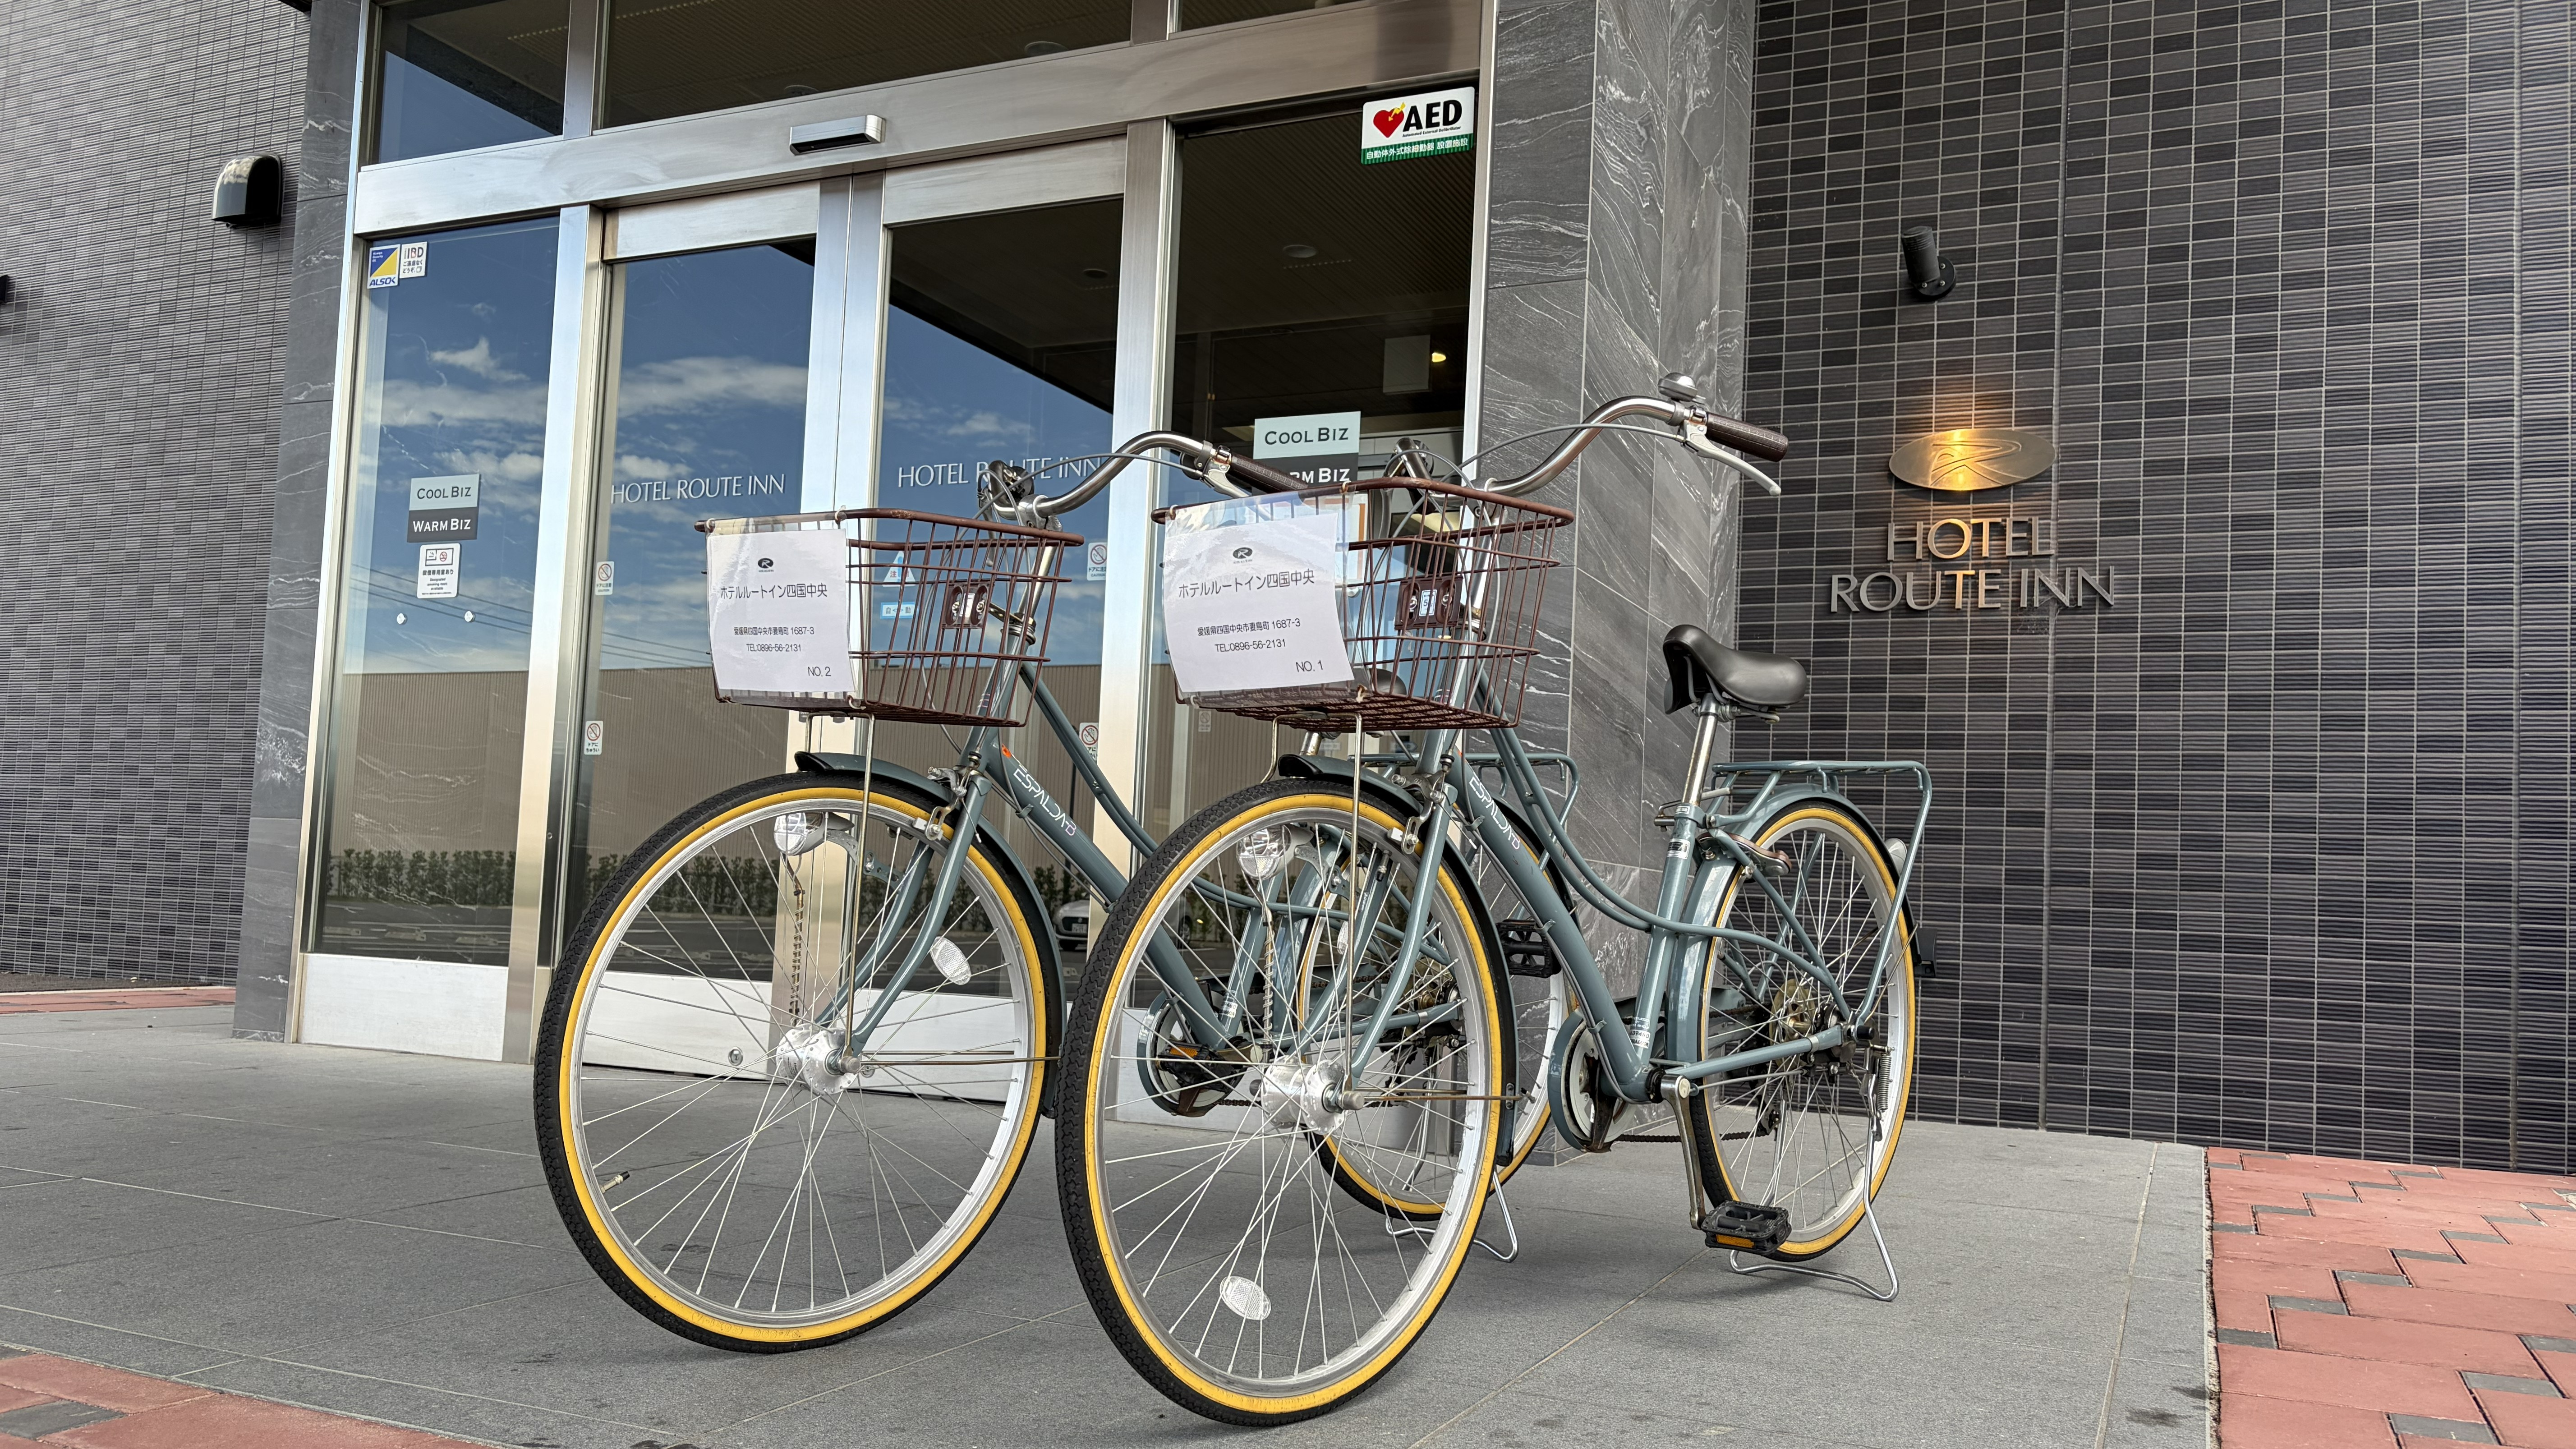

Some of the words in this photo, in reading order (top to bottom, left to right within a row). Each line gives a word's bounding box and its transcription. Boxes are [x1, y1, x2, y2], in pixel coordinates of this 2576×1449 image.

[1403, 99, 1462, 132] AED
[369, 277, 396, 286] ALSOK
[1265, 431, 1313, 445] COOL
[1318, 427, 1348, 442] BIZ
[898, 463, 969, 488] HOTEL
[1319, 468, 1350, 483] BIZ
[417, 488, 448, 499] COOL
[451, 486, 471, 497] BIZ
[611, 481, 671, 504] HOTEL
[677, 476, 743, 499] ROUTE
[749, 474, 785, 495] INN
[413, 520, 448, 532] WARM
[451, 518, 471, 530] BIZ
[1887, 516, 2055, 561] HOTEL
[1179, 568, 1315, 598] ホテルルートイン四国中央
[1831, 569, 2001, 612] ROUTE
[2020, 566, 2115, 608] INN
[721, 583, 828, 599] ホテルルートイン四国中央
[791, 627, 814, 635] 1687-3
[1272, 618, 1301, 629] 1687-3
[746, 644, 801, 652] TEL:0896-56-2131
[1215, 639, 1286, 652] TEL:0896-56-2131
